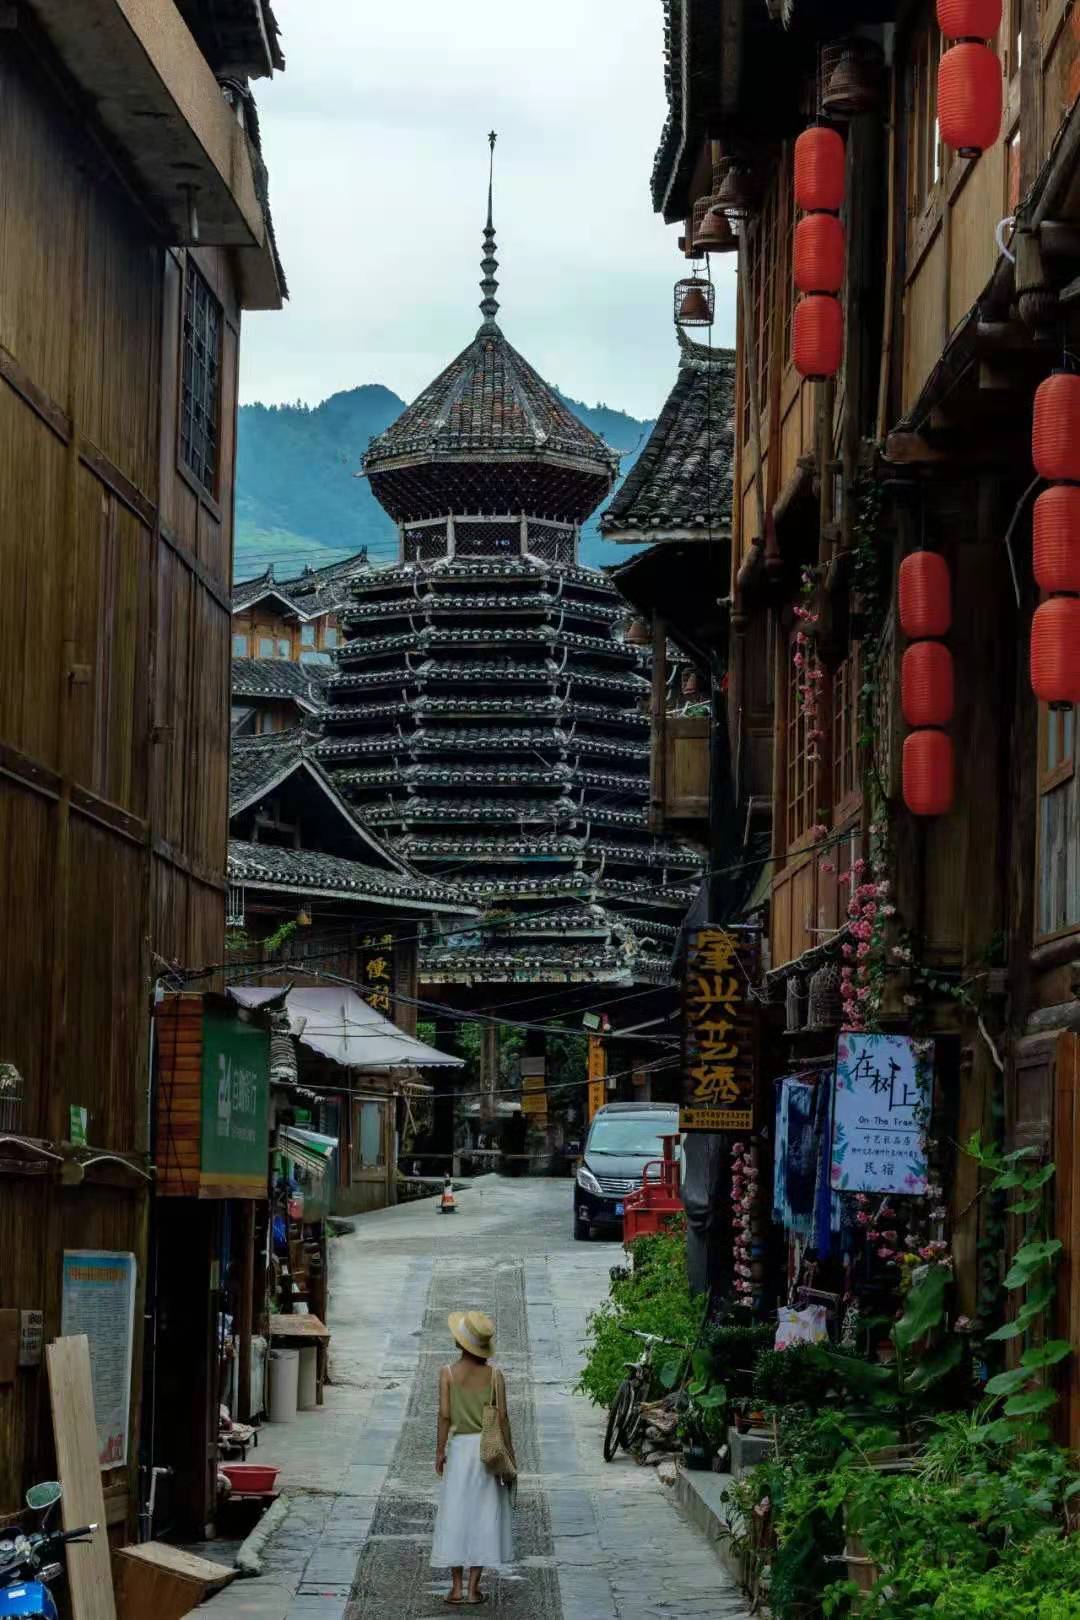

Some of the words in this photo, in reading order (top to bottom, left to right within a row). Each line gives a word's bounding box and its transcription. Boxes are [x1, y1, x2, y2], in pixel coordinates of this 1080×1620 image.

[849, 1049, 918, 1112] 在树上
[858, 1115, 869, 1124] On
[875, 1116, 888, 1126] The
[894, 1117, 913, 1127] Tree
[864, 1162, 895, 1176] 民宿
